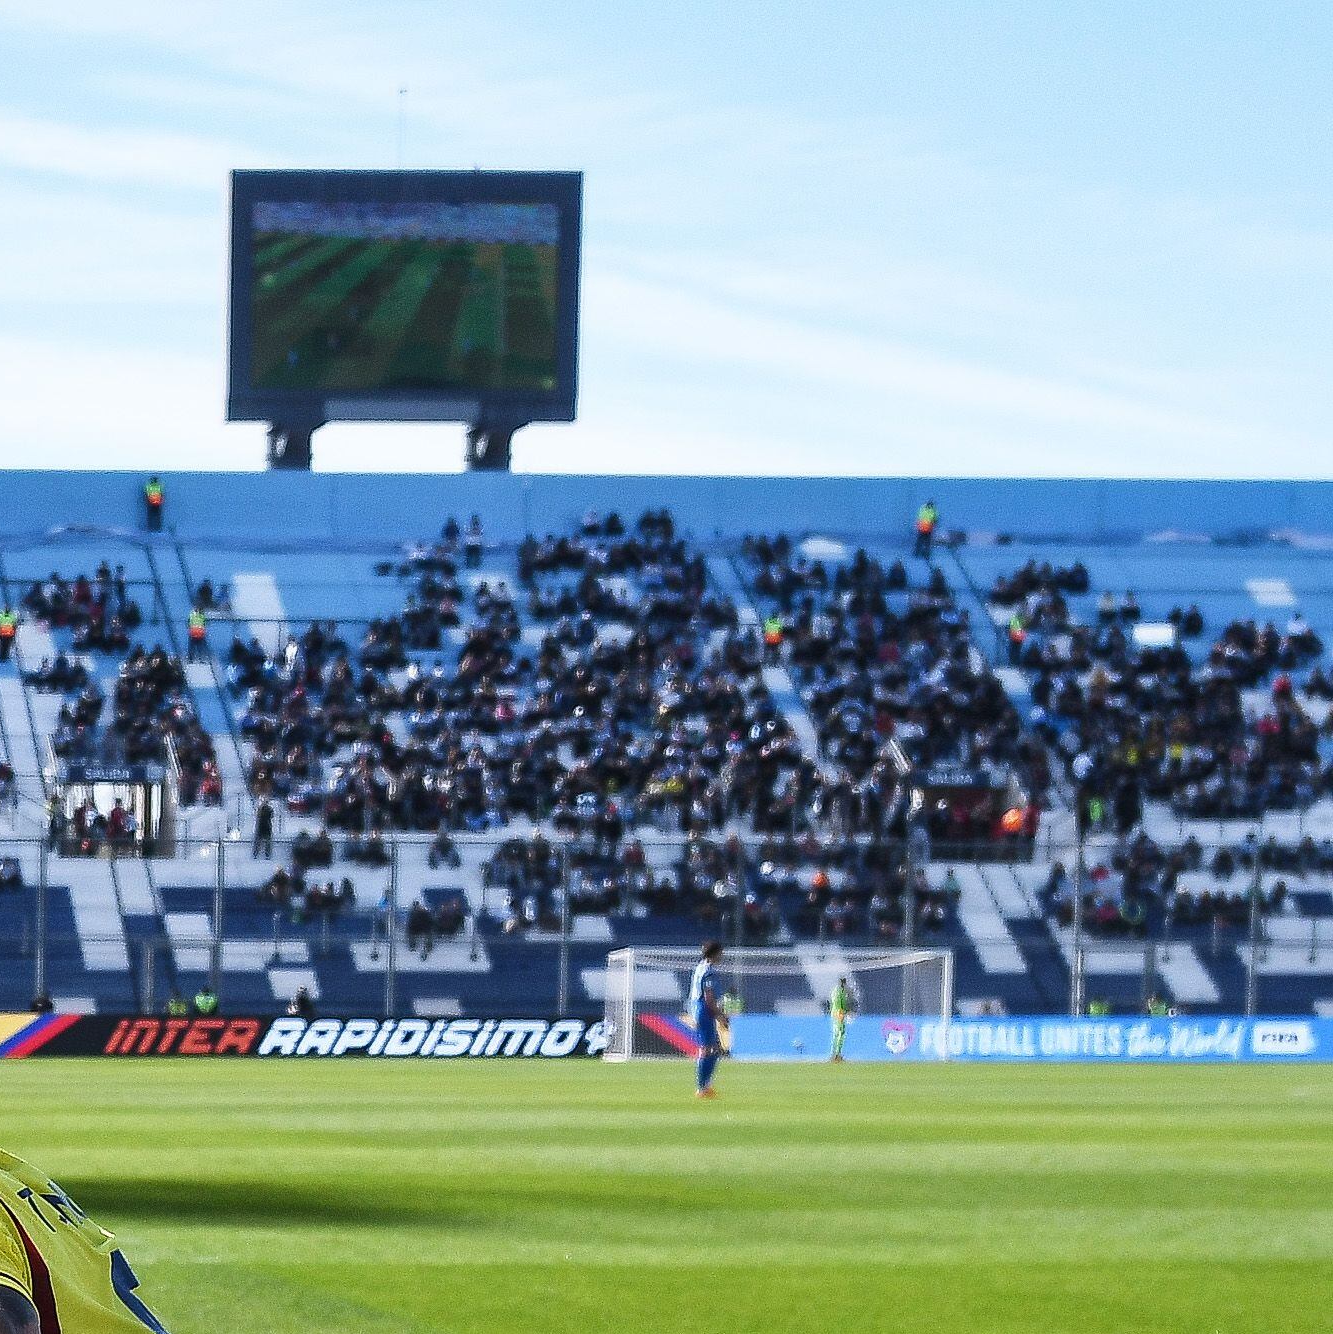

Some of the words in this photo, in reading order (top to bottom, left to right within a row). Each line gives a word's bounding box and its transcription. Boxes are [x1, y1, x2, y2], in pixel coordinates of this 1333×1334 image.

[104, 1019, 260, 1056] INTER
[259, 1017, 584, 1057] RAPIDISIMO
[920, 1023, 1033, 1056] FOOTBALL
[1040, 1023, 1121, 1056] UNITES
[1129, 1021, 1167, 1057] the
[1169, 1020, 1245, 1059] World
